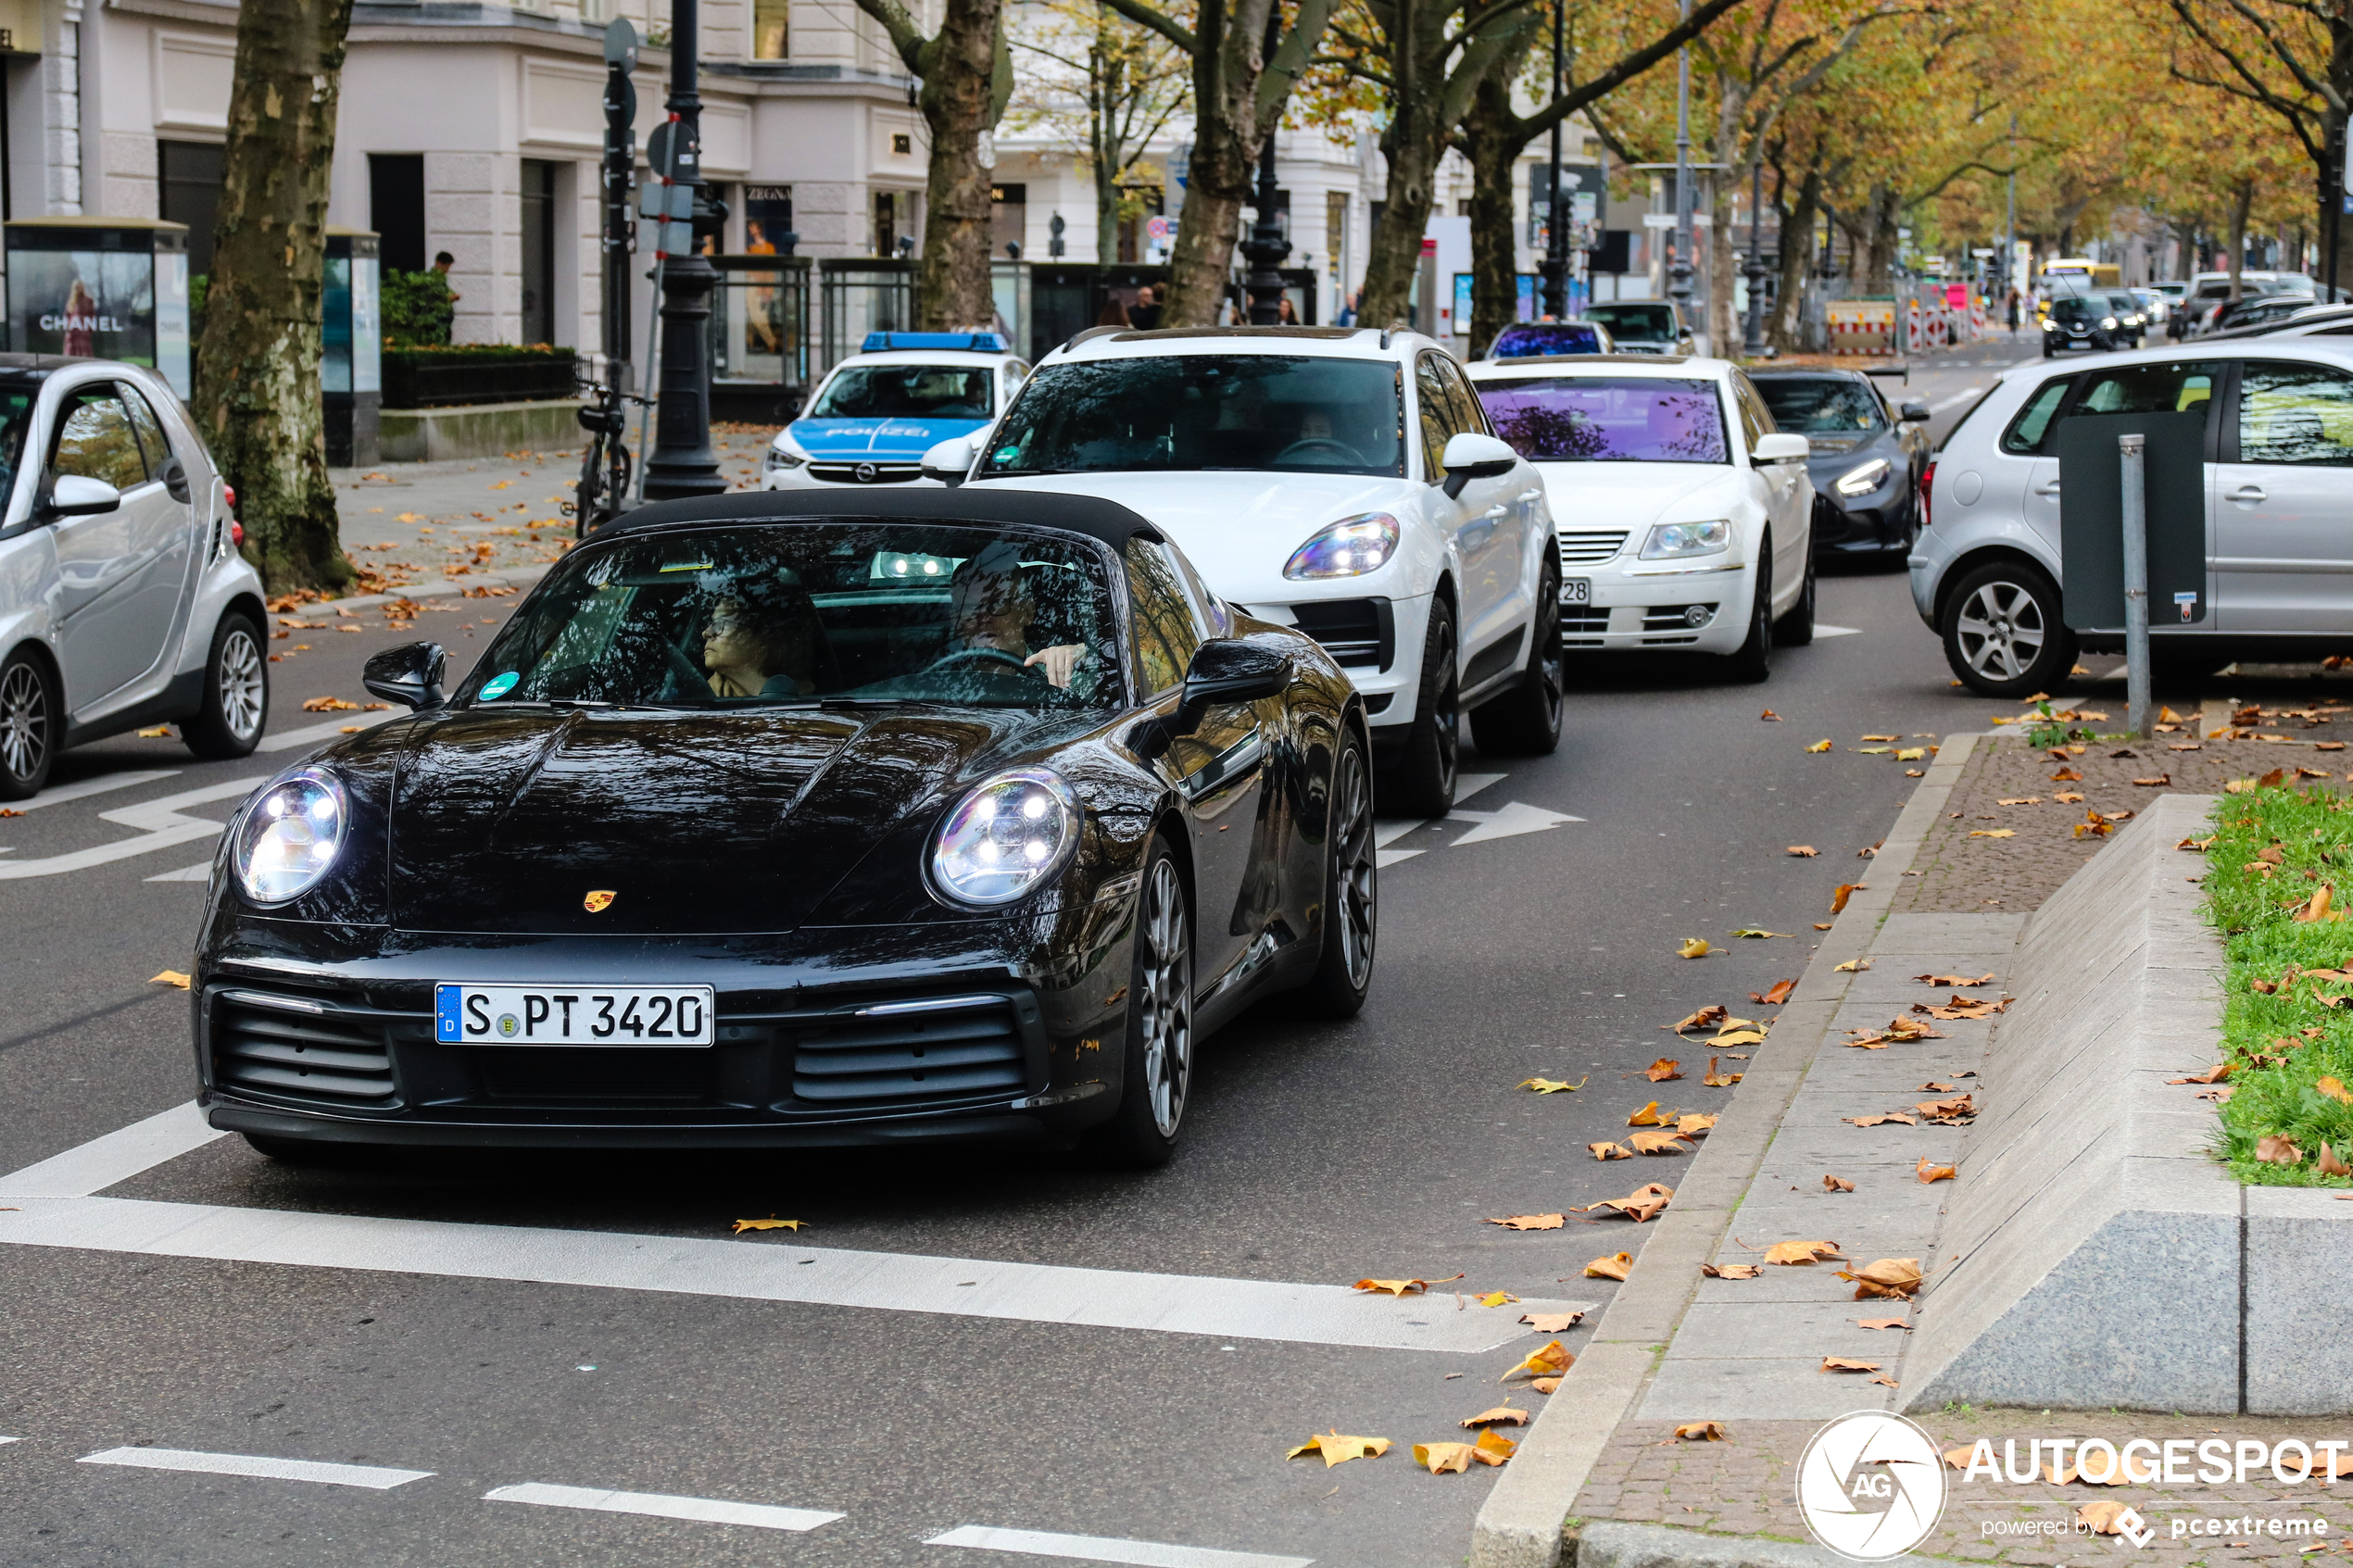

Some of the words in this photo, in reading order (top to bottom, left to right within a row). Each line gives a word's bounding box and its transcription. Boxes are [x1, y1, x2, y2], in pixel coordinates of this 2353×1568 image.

[747, 187, 792, 201] ZEGNA
[39, 314, 124, 332] CHANEL
[825, 427, 931, 438] POLIZEI
[464, 994, 491, 1035] S
[522, 995, 579, 1037] PT
[590, 995, 703, 1038] 3420
[445, 1020, 455, 1032] D
